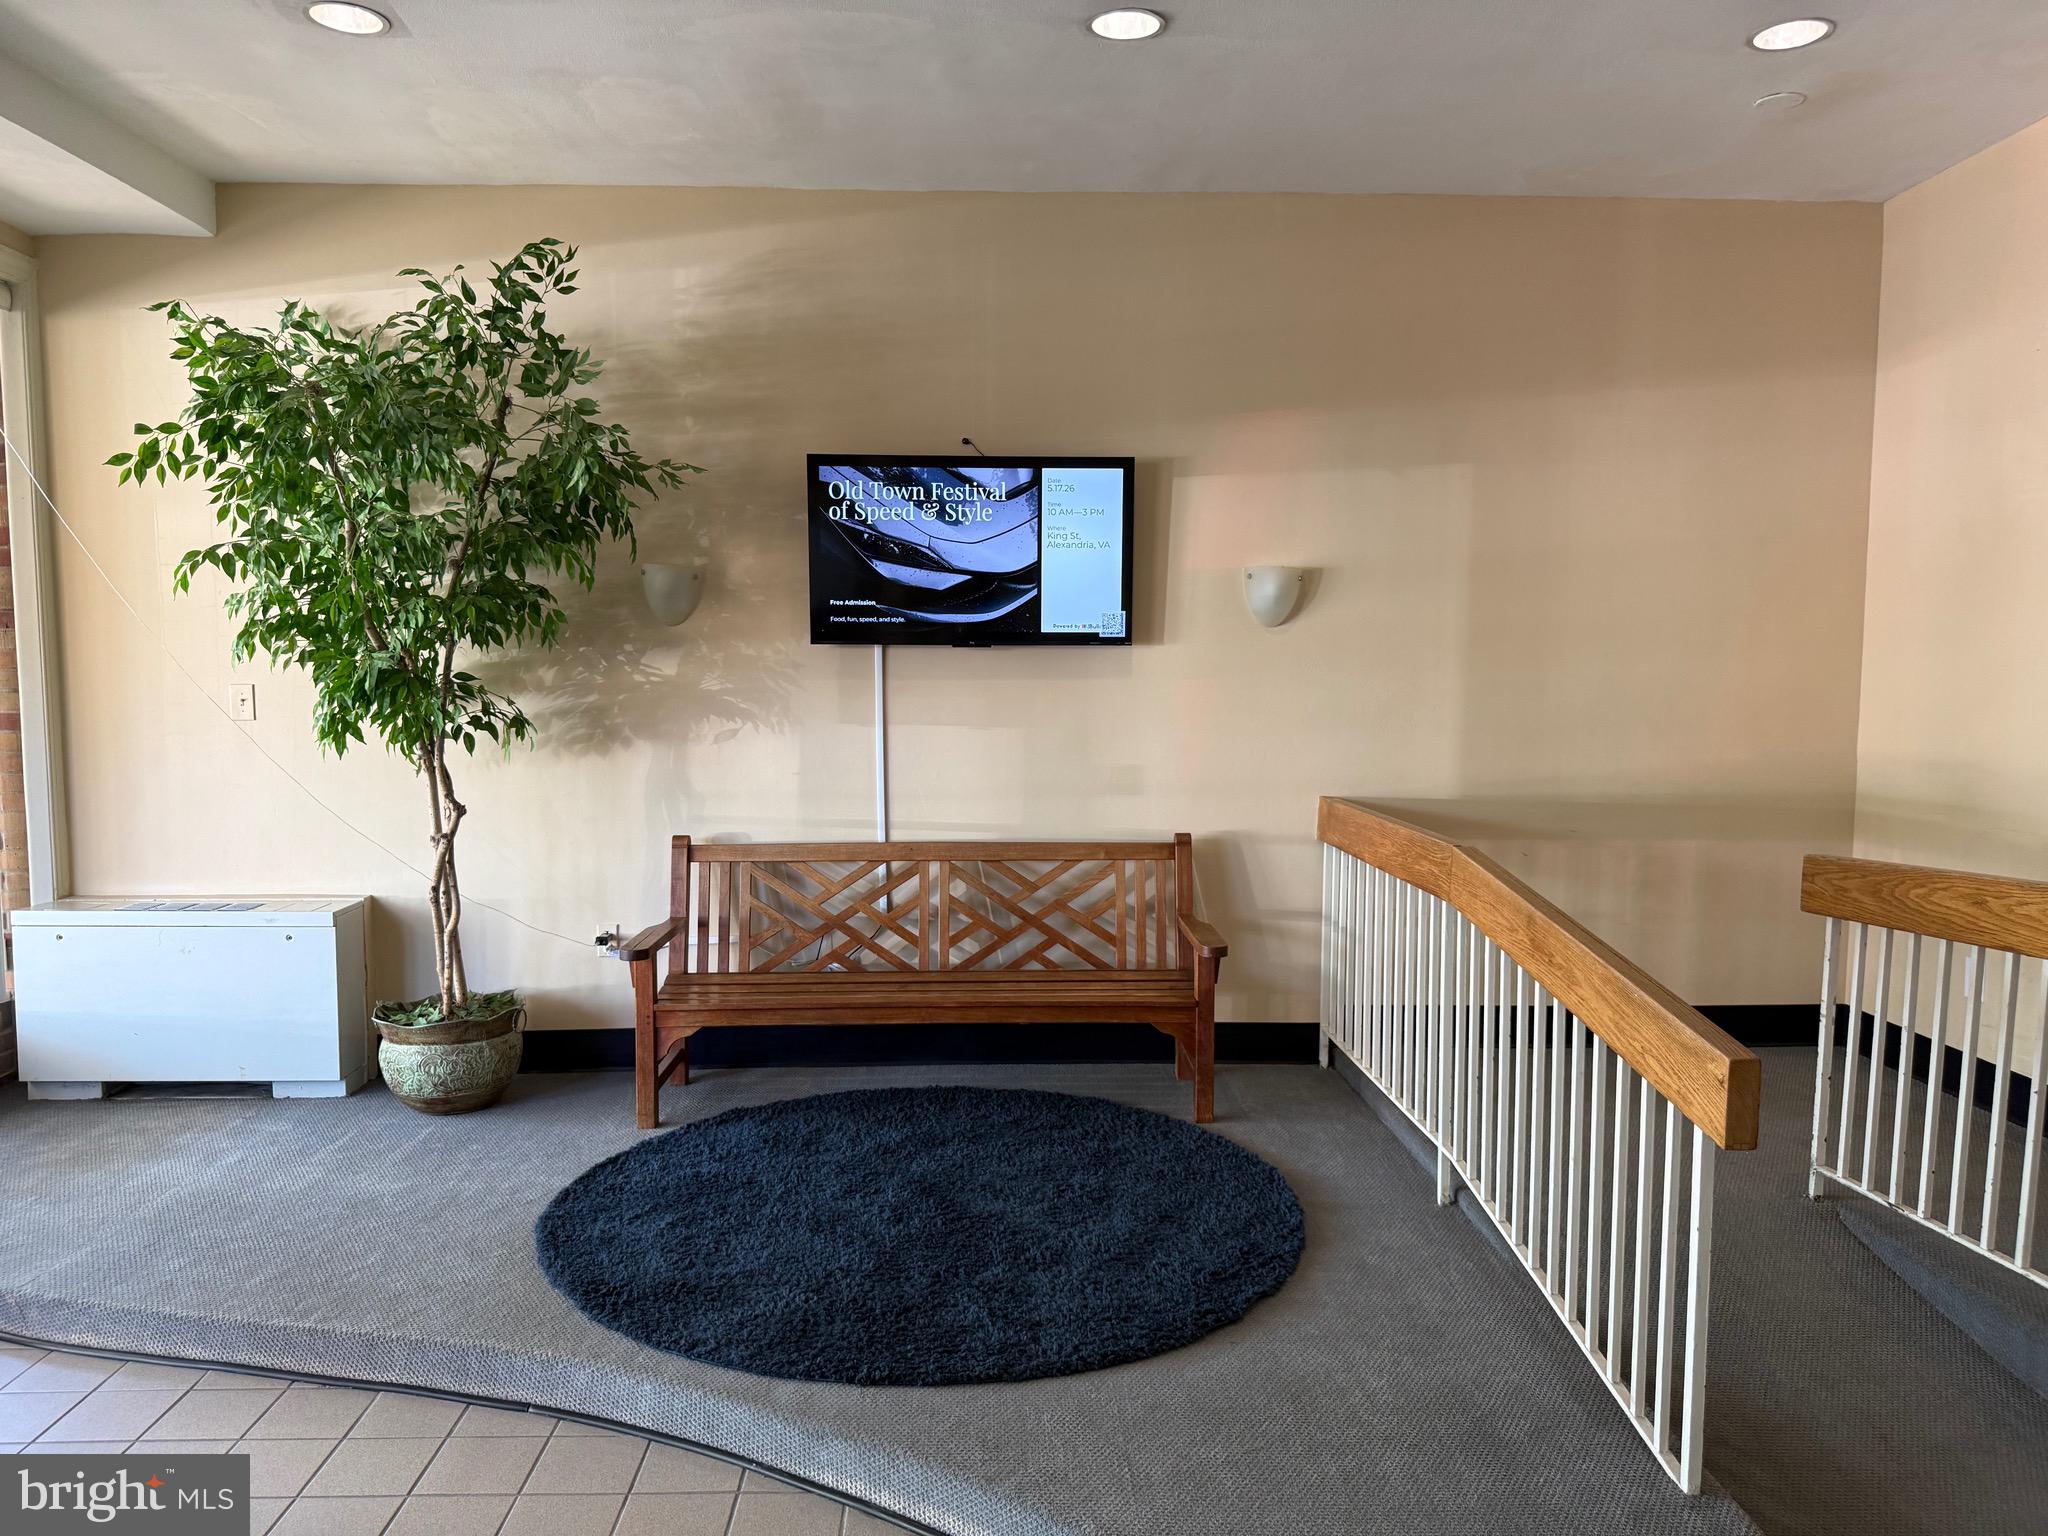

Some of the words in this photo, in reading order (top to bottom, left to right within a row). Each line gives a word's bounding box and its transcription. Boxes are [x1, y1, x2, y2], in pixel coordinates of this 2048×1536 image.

[829, 481, 863, 500] Old
[869, 482, 925, 501] Town
[931, 481, 1007, 501] Festival
[1047, 484, 1075, 492] 5.17.26
[829, 501, 850, 520] of
[854, 501, 915, 524] Speed
[921, 503, 940, 521] &
[945, 502, 993, 525] Style
[1047, 508, 1057, 516] 10
[1090, 508, 1104, 516] PM
[1047, 532, 1068, 541] King
[1070, 532, 1081, 541] St,
[1047, 541, 1096, 549] Alexandria,
[1098, 541, 1111, 549] VA
